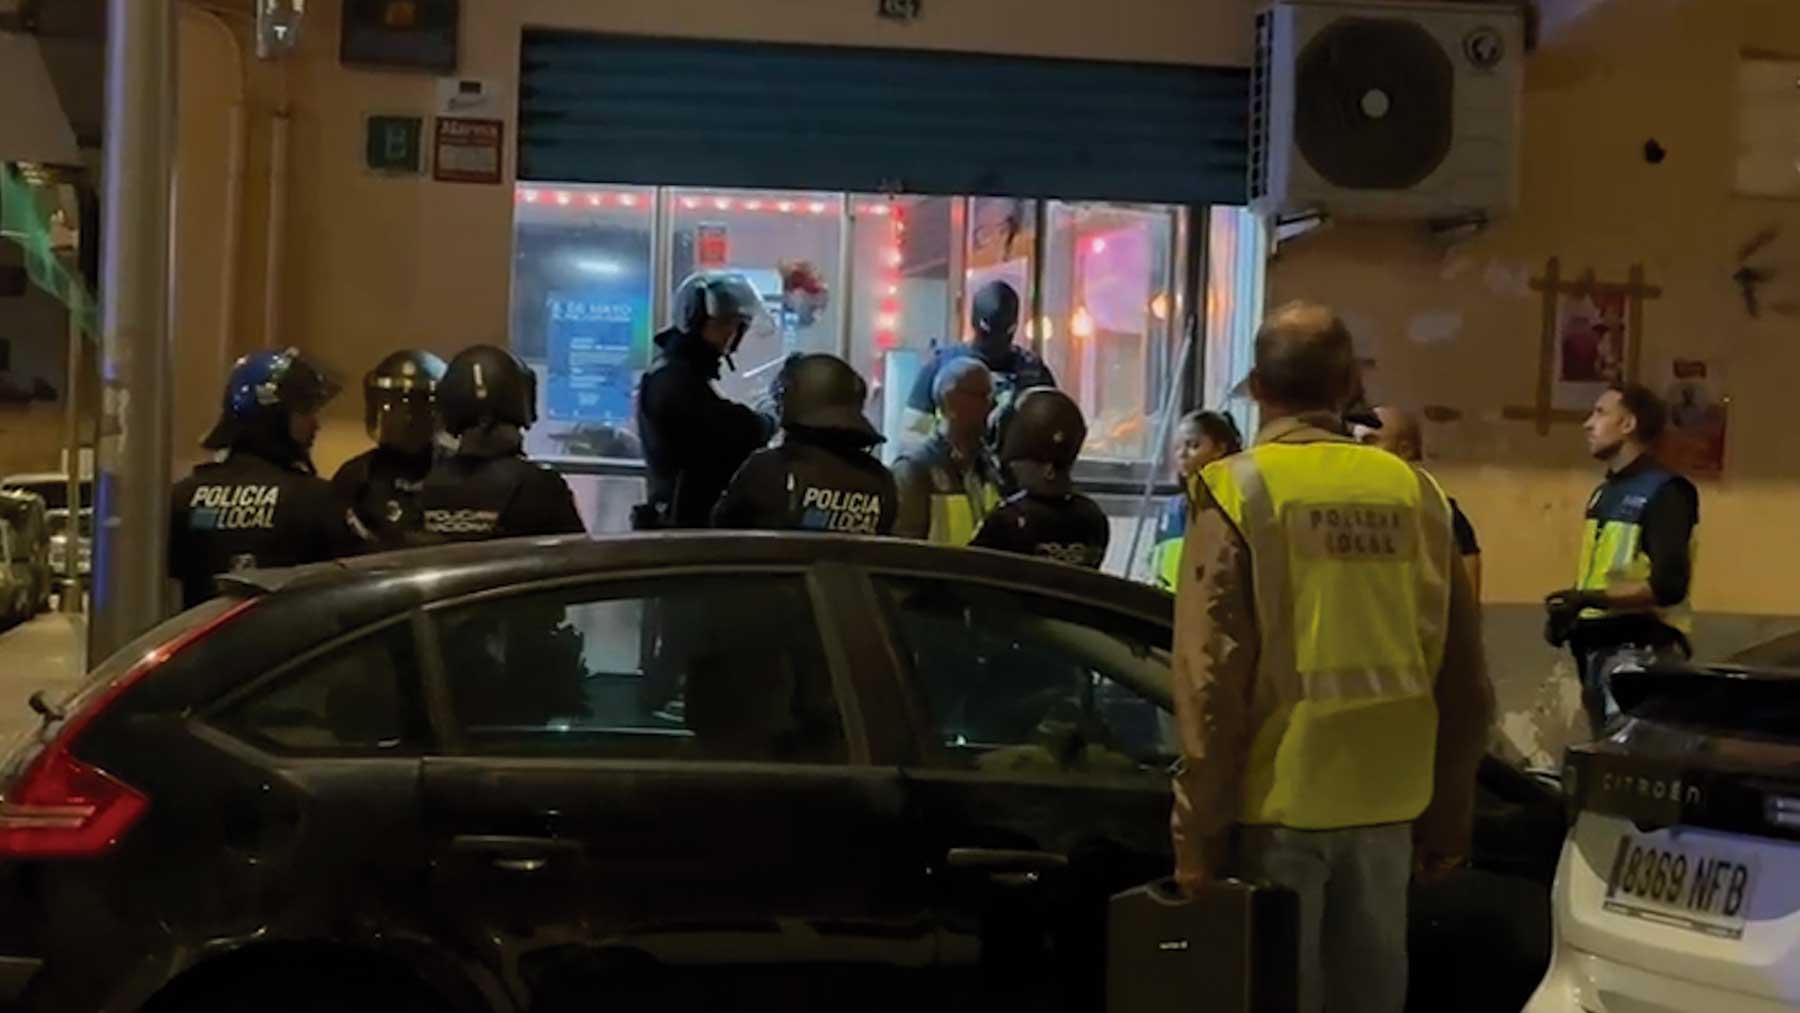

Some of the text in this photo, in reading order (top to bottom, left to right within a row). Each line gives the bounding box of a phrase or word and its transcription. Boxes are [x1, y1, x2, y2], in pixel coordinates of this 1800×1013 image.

[189, 484, 280, 508] POLICIA
[803, 487, 881, 515] POLICIA
[216, 505, 275, 530] LOCAL
[1621, 846, 1748, 917] 8369 NFB
